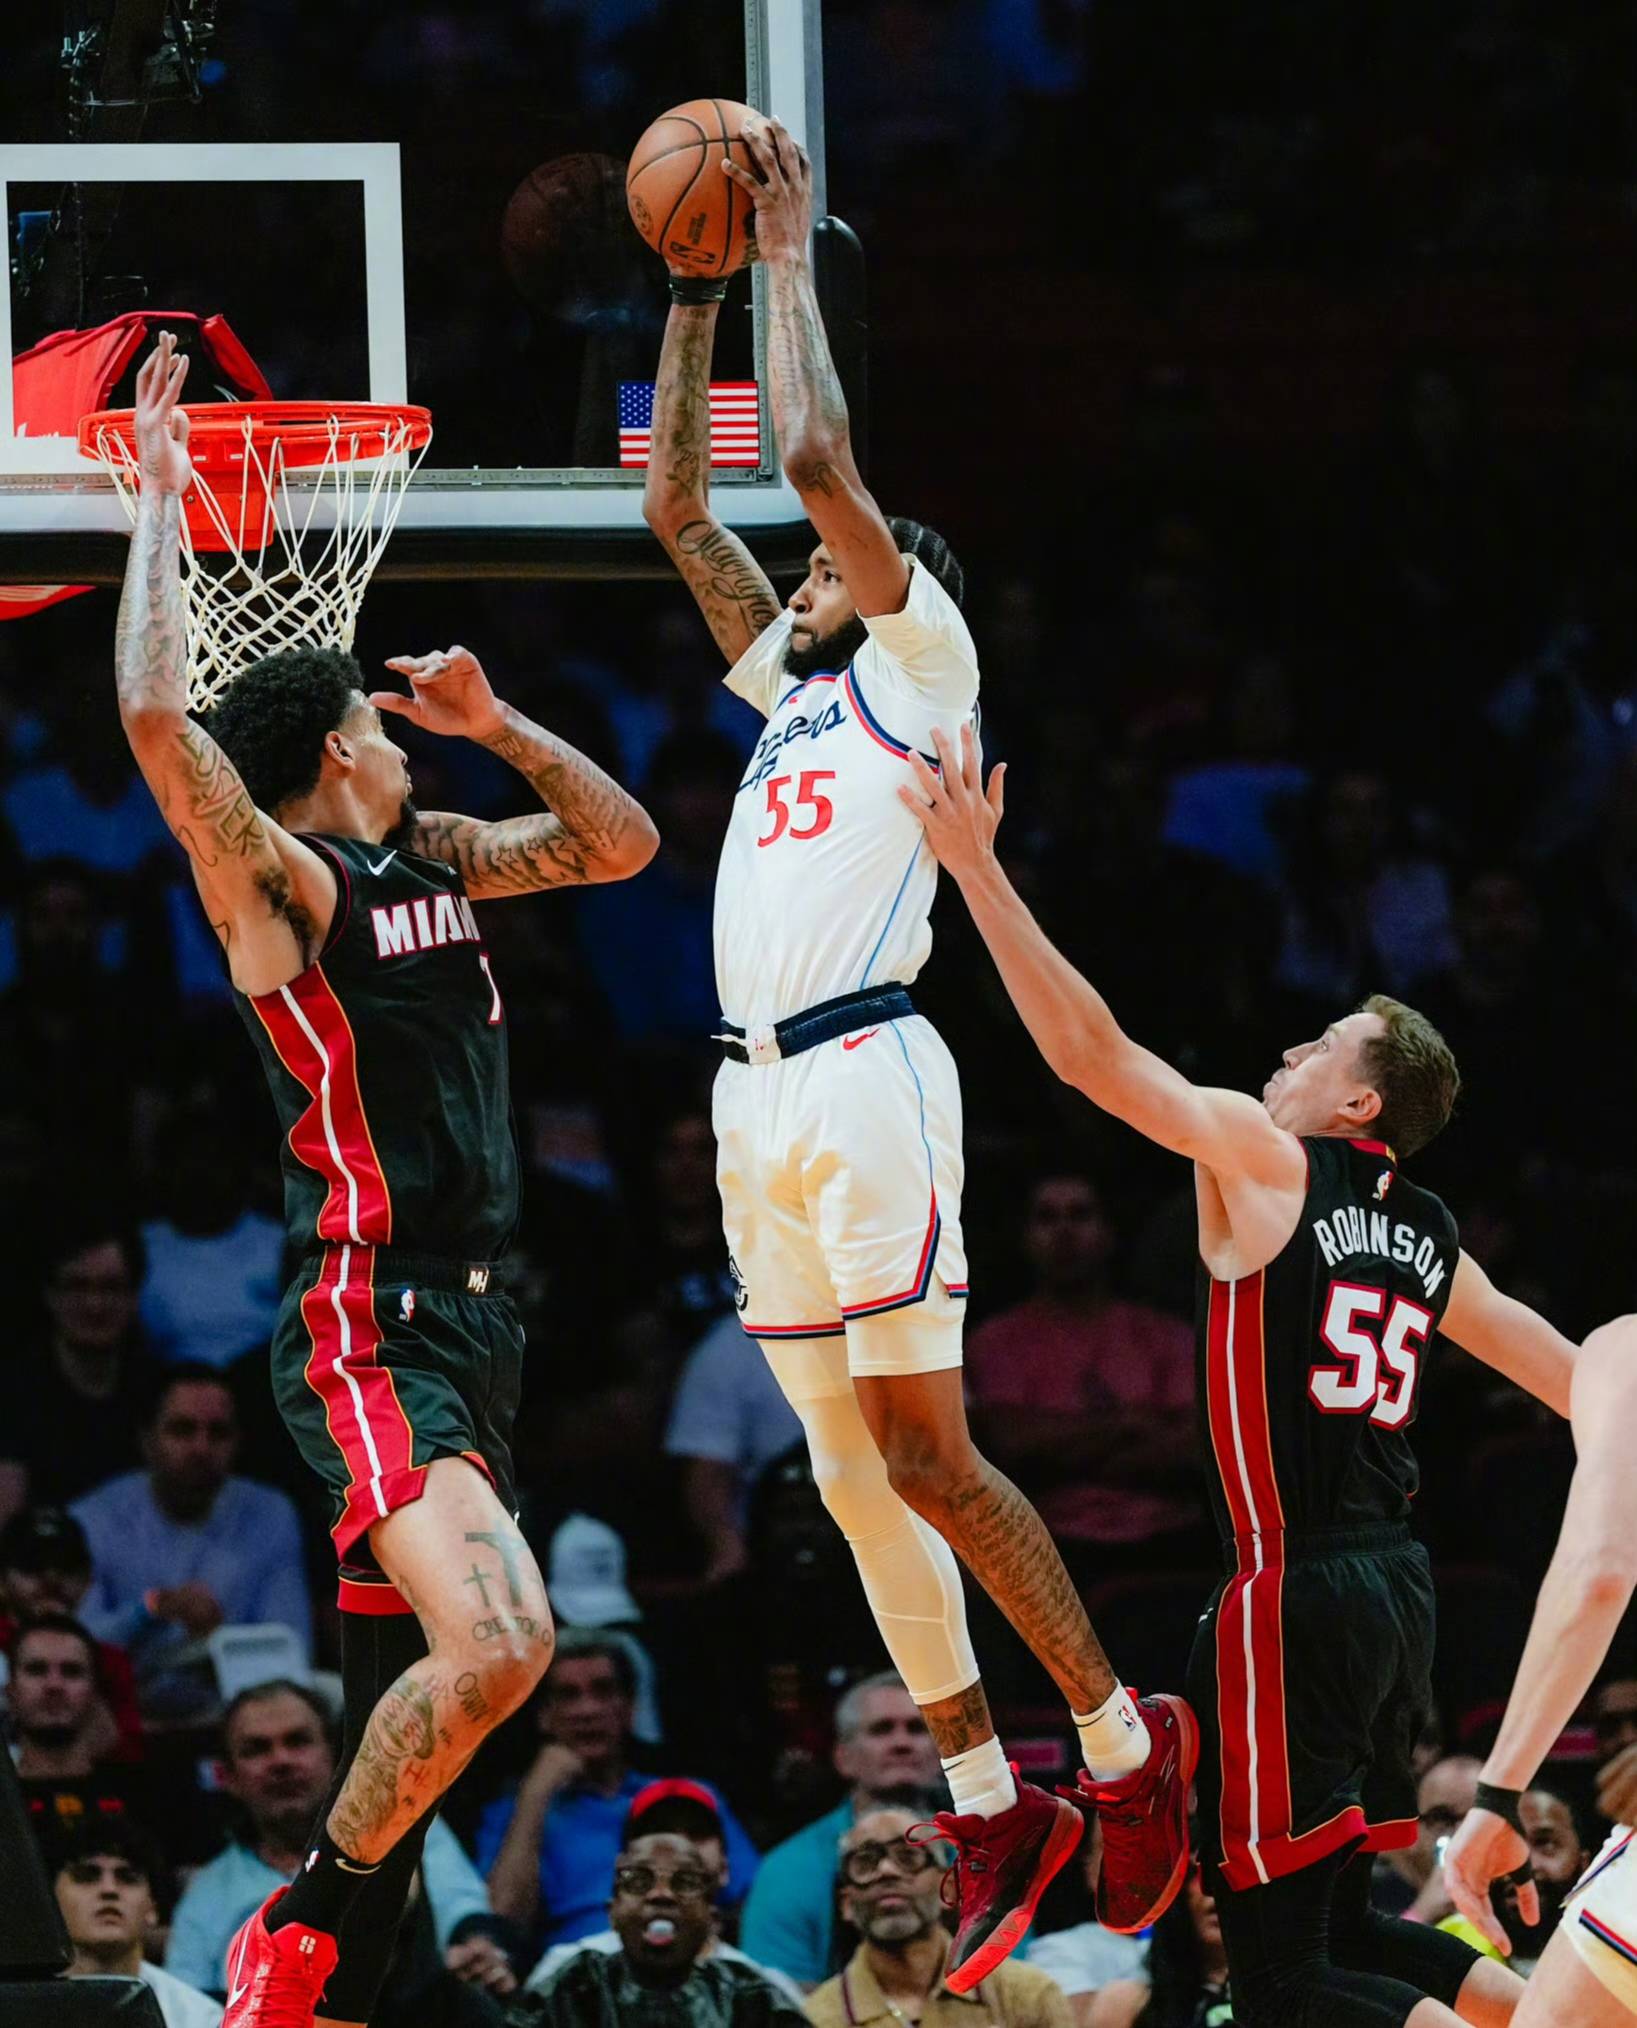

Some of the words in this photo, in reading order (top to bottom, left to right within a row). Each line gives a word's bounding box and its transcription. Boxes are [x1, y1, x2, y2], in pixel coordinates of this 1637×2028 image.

[757, 770, 837, 848] 55
[370, 891, 481, 960] MIAM
[1312, 1205, 1448, 1299] ROBINSON
[1307, 1280, 1435, 1432] 55
